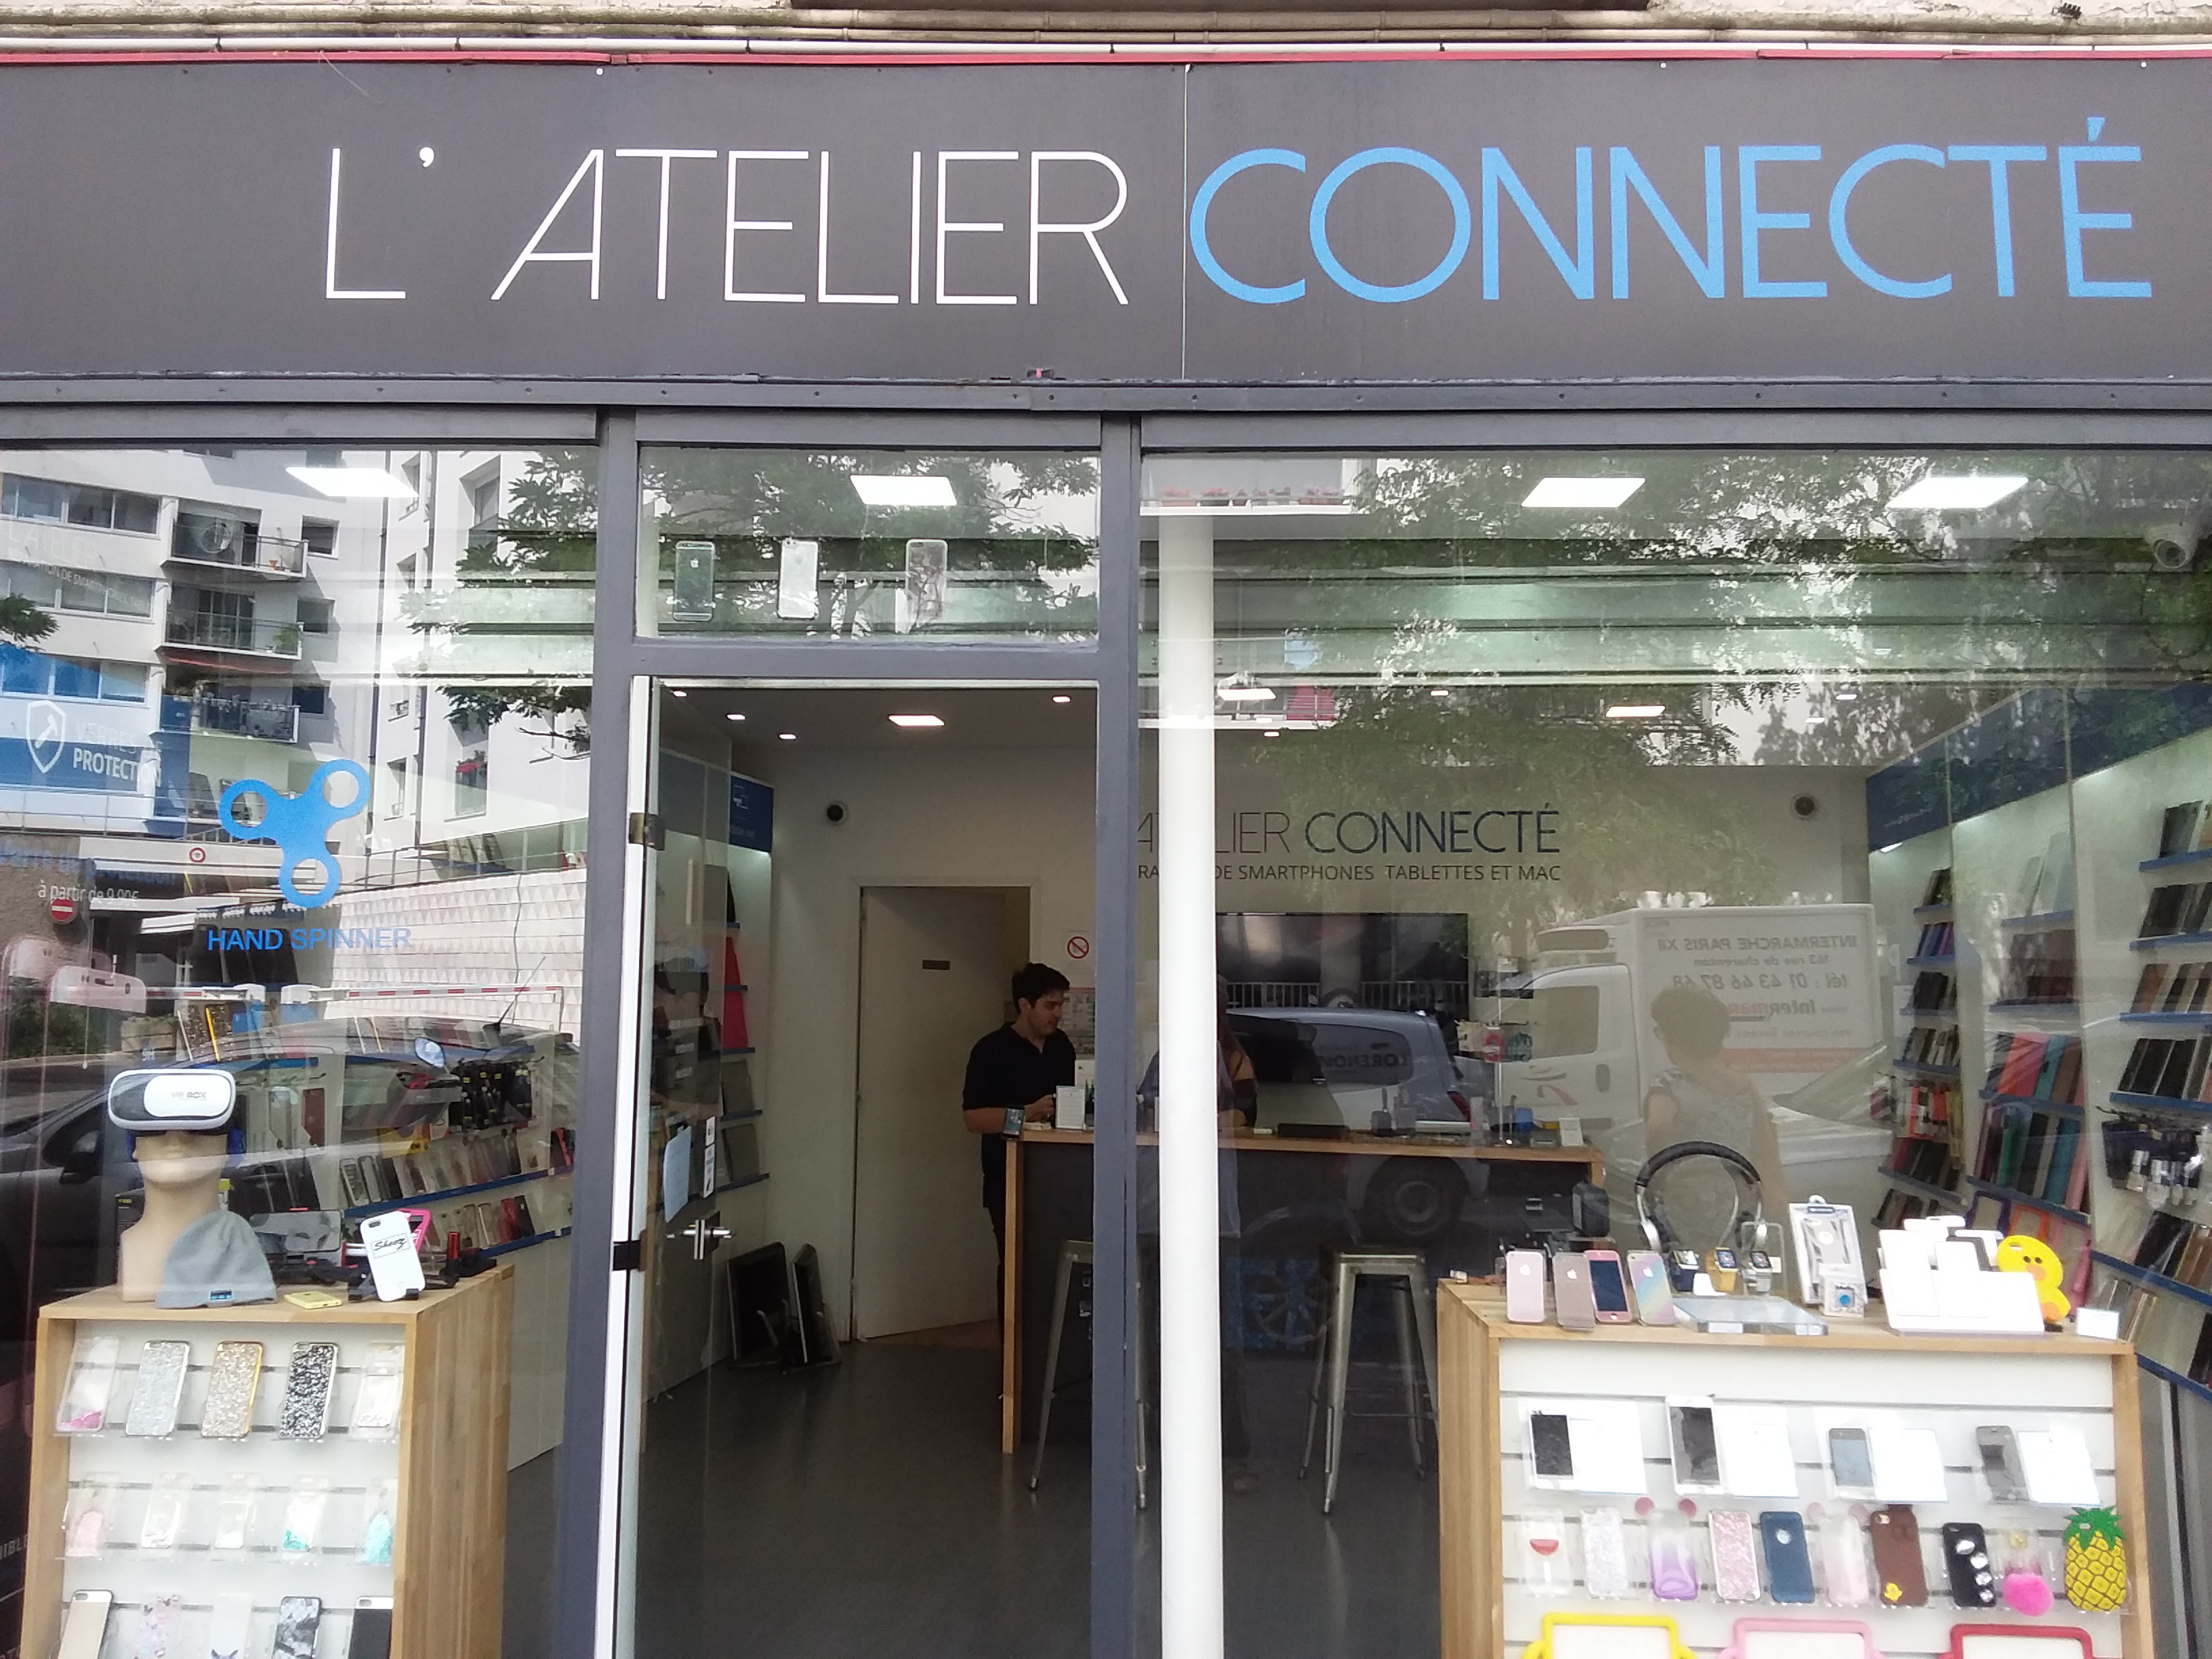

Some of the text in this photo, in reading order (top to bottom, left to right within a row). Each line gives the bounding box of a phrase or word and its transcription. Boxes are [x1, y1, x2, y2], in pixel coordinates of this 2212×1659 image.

[490, 148, 1130, 306] ATELIER
[1189, 117, 2153, 304] CONNECTÉ
[1305, 802, 1560, 854] CONNECTÉ
[1238, 865, 1374, 880] SMARTPHONES
[1385, 865, 1485, 880] TABLETTES
[1491, 865, 1513, 880] ET
[1518, 865, 1561, 881] MAC
[49, 883, 86, 904] partir
[88, 887, 104, 904] de
[207, 927, 413, 951] HAND SPINNER
[186, 1091, 207, 1099] BOX
